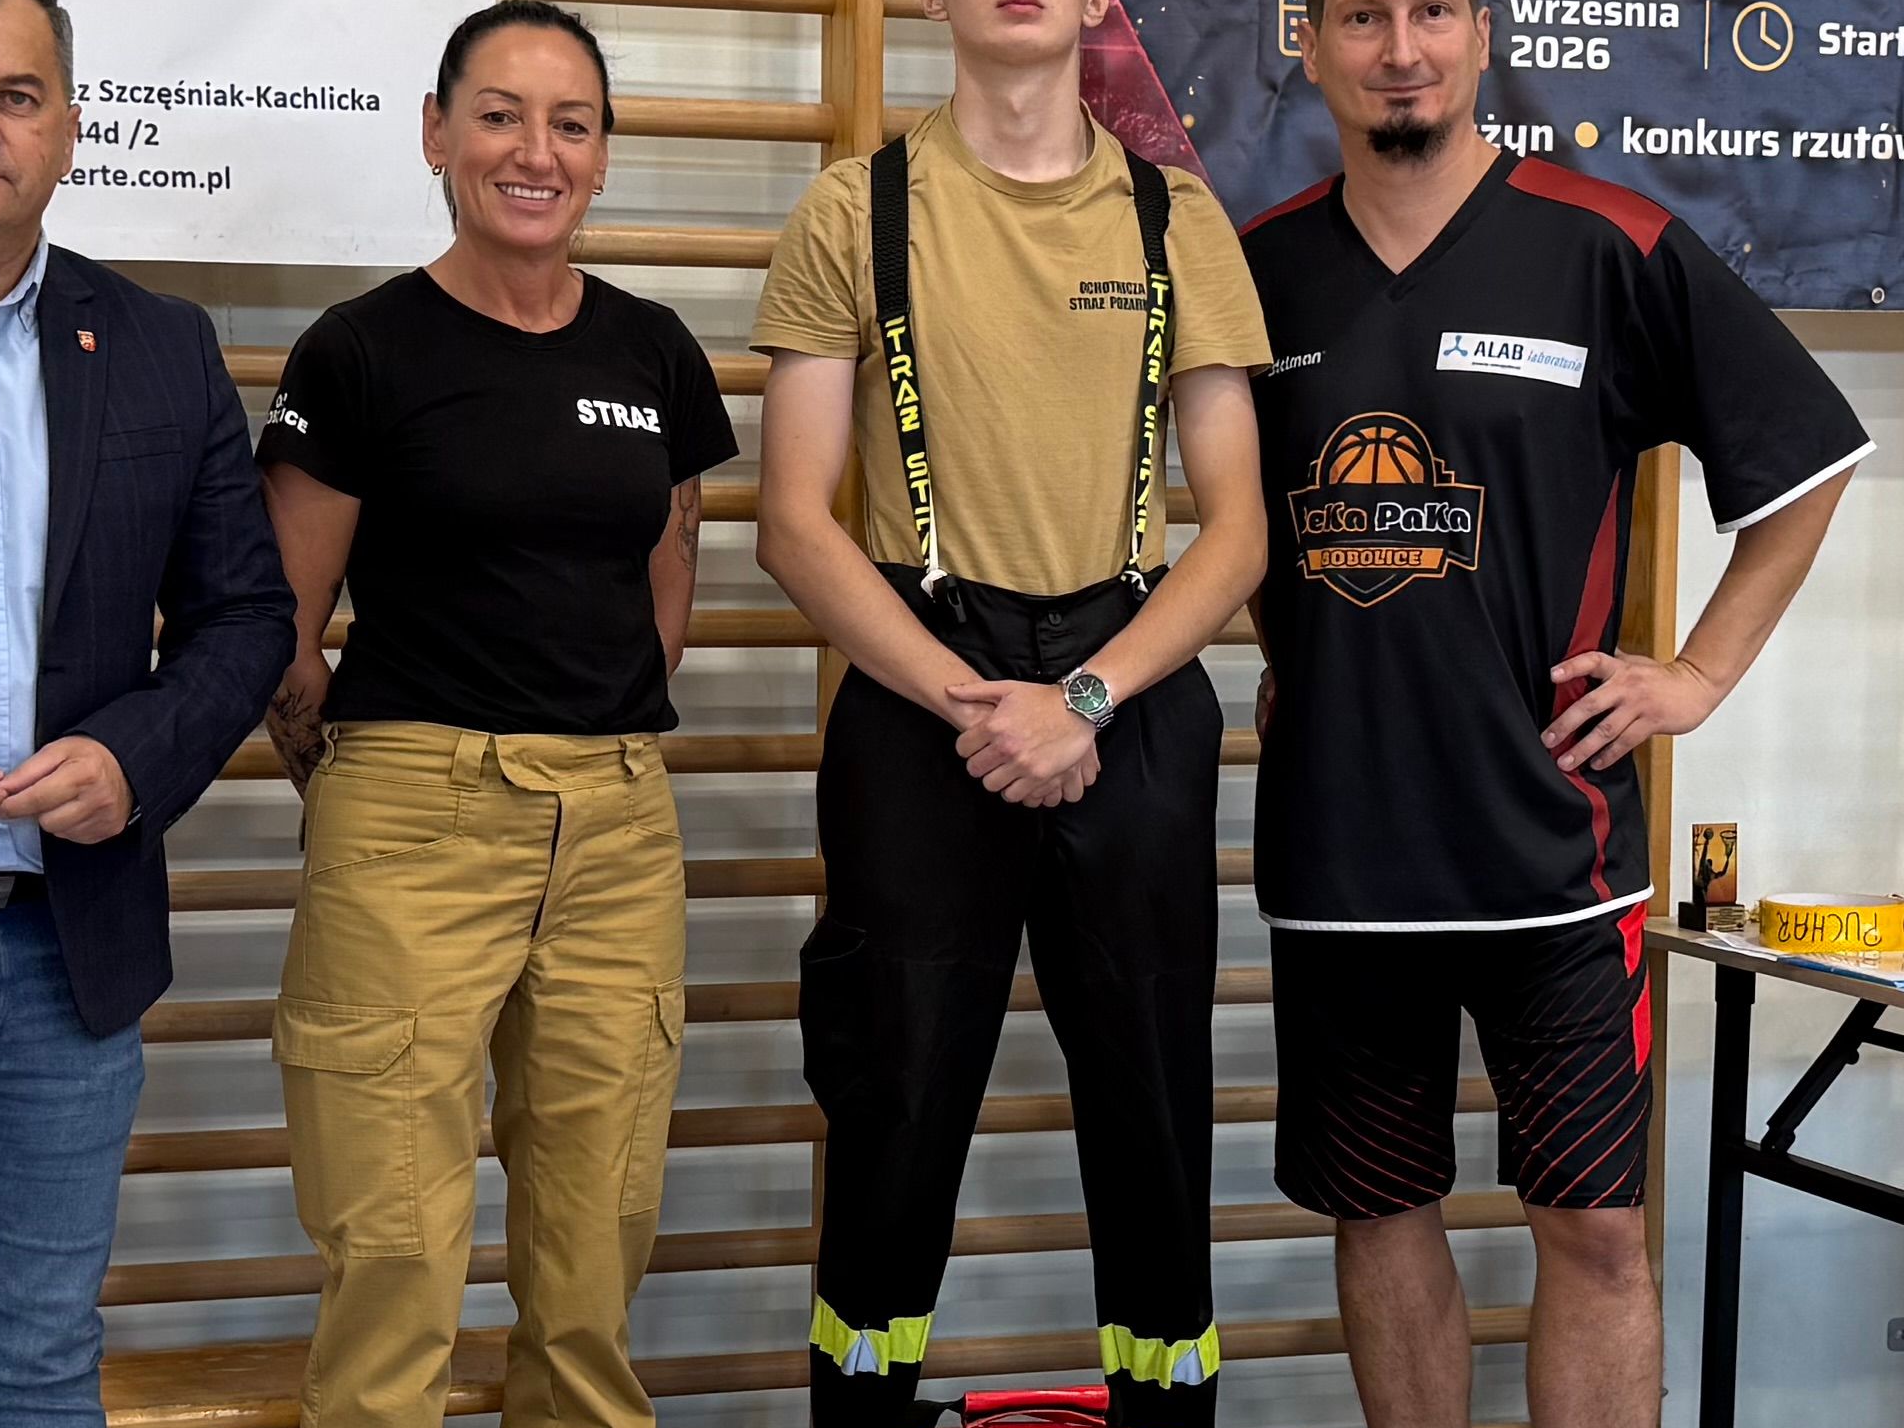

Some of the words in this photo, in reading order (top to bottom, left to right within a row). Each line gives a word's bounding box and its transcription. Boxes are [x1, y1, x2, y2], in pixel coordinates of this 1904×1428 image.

[1510, 34, 1611, 70] 2026
[98, 79, 380, 112] Szczęśniak-Kachlicka
[128, 118, 160, 151] /2
[1622, 116, 1780, 157] konkurs
[1474, 341, 1524, 360] ALAB
[1527, 351, 1583, 372] laboratoria
[1776, 910, 1883, 947] PUCHAR
